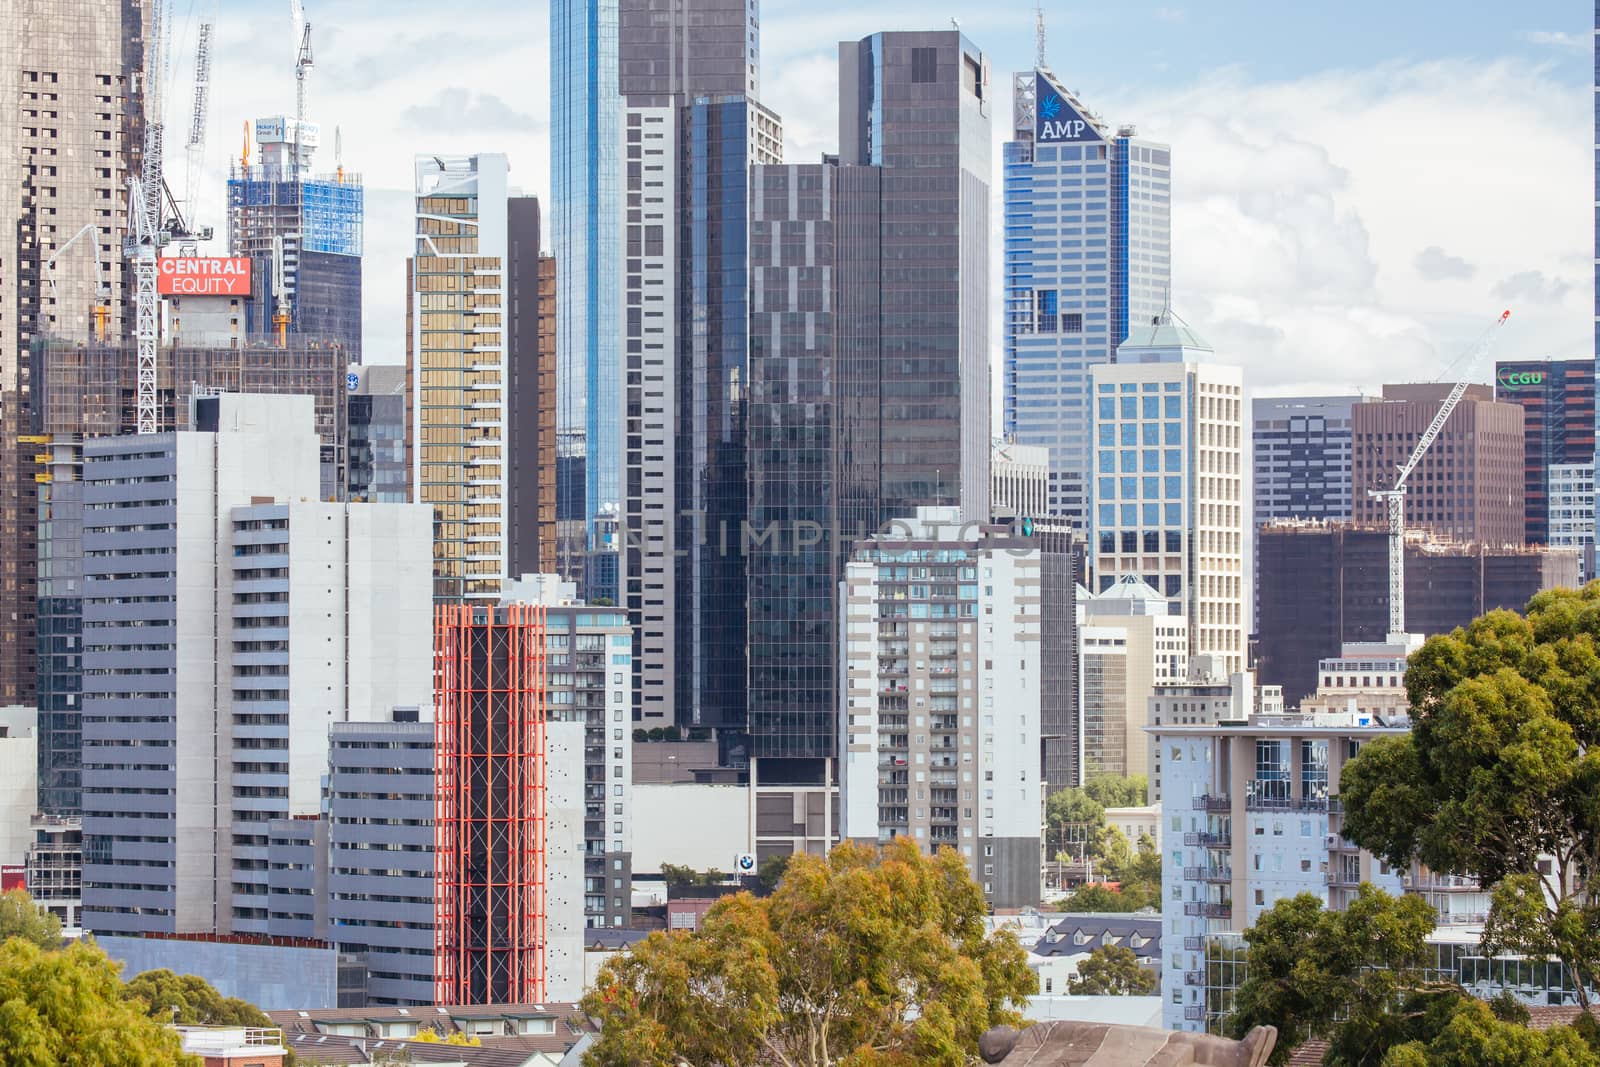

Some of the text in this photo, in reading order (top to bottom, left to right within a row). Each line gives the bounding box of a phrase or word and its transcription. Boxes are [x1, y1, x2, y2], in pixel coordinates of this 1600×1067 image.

[1040, 120, 1086, 139] AMP
[161, 260, 246, 275] CENTRAL
[172, 278, 236, 293] EQUITY
[1509, 372, 1542, 385] CGU
